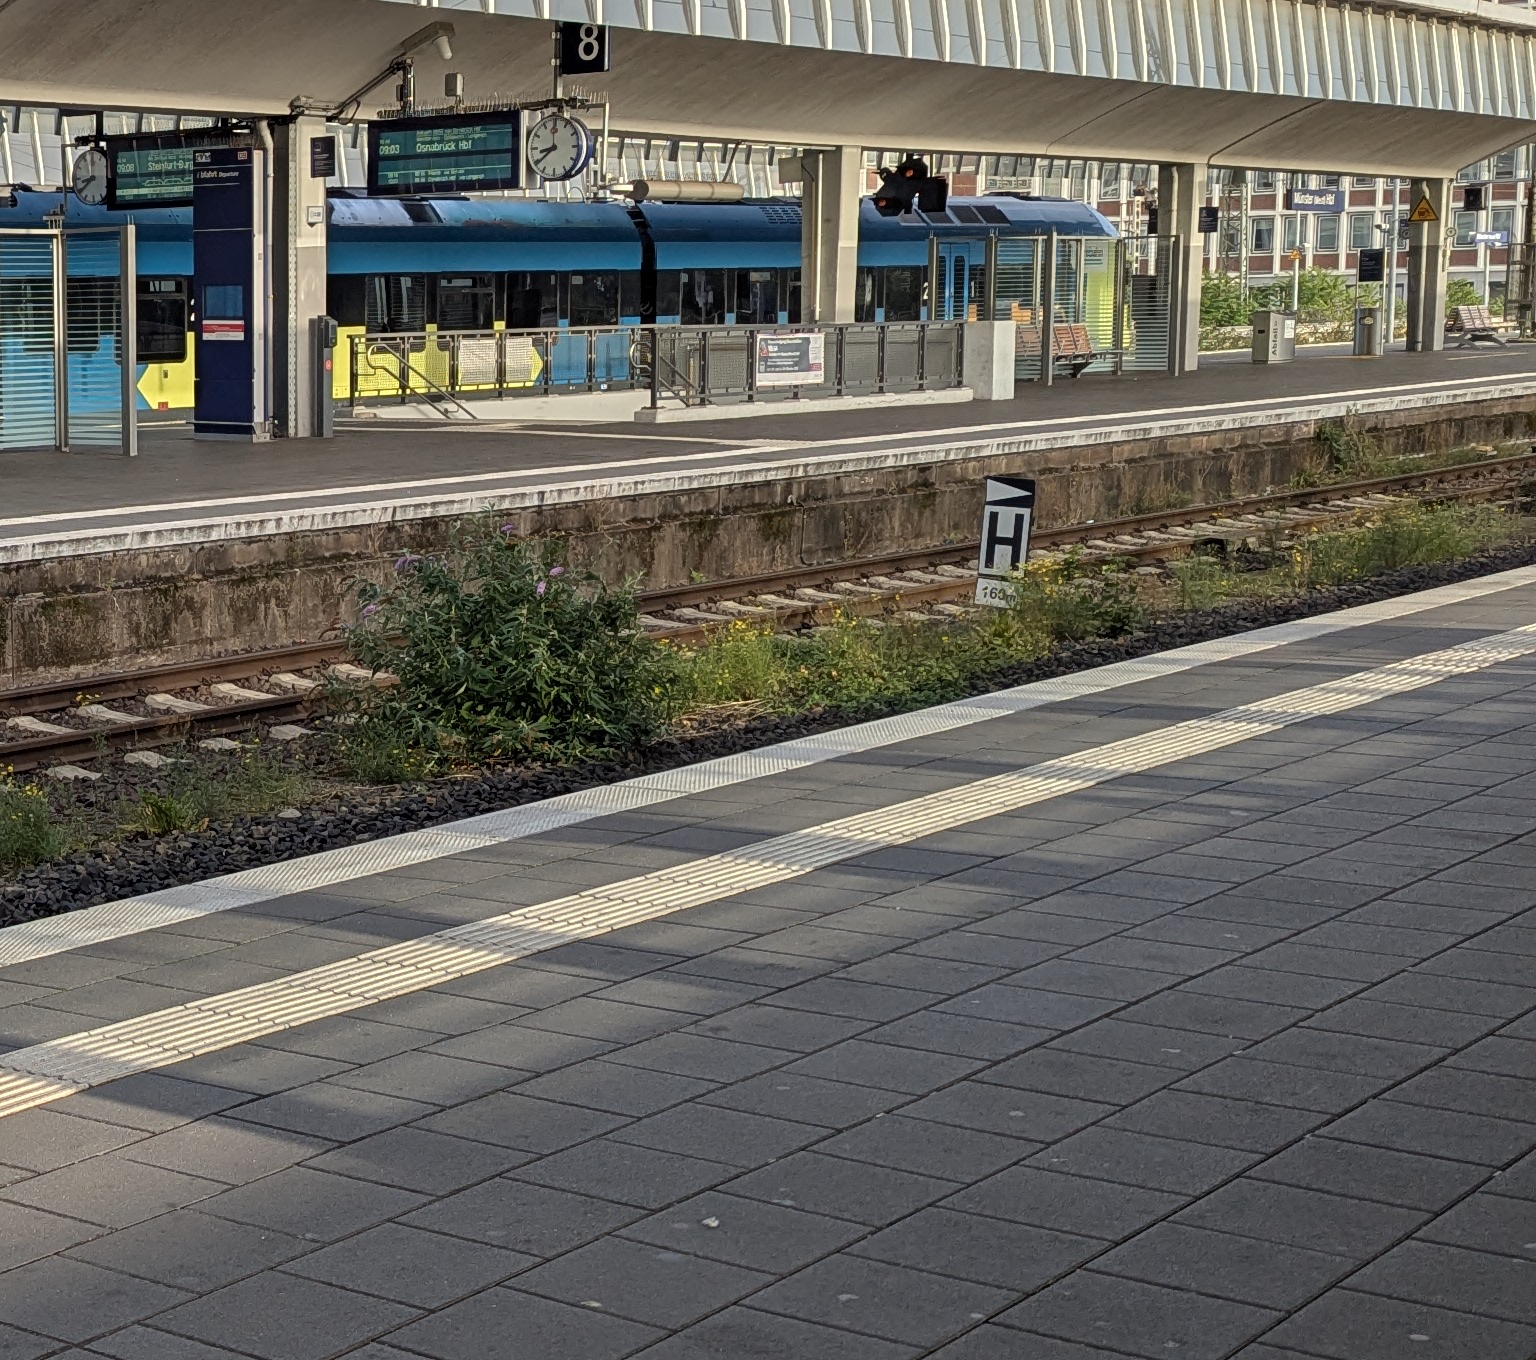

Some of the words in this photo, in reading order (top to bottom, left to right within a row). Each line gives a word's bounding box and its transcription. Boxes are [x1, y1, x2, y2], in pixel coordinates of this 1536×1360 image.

[577, 23, 600, 62] 8
[379, 144, 400, 156] 09:03
[416, 141, 456, 153] Osnabrück
[458, 139, 472, 151] Hbf
[117, 163, 135, 174] 09:08
[984, 511, 1025, 572] H
